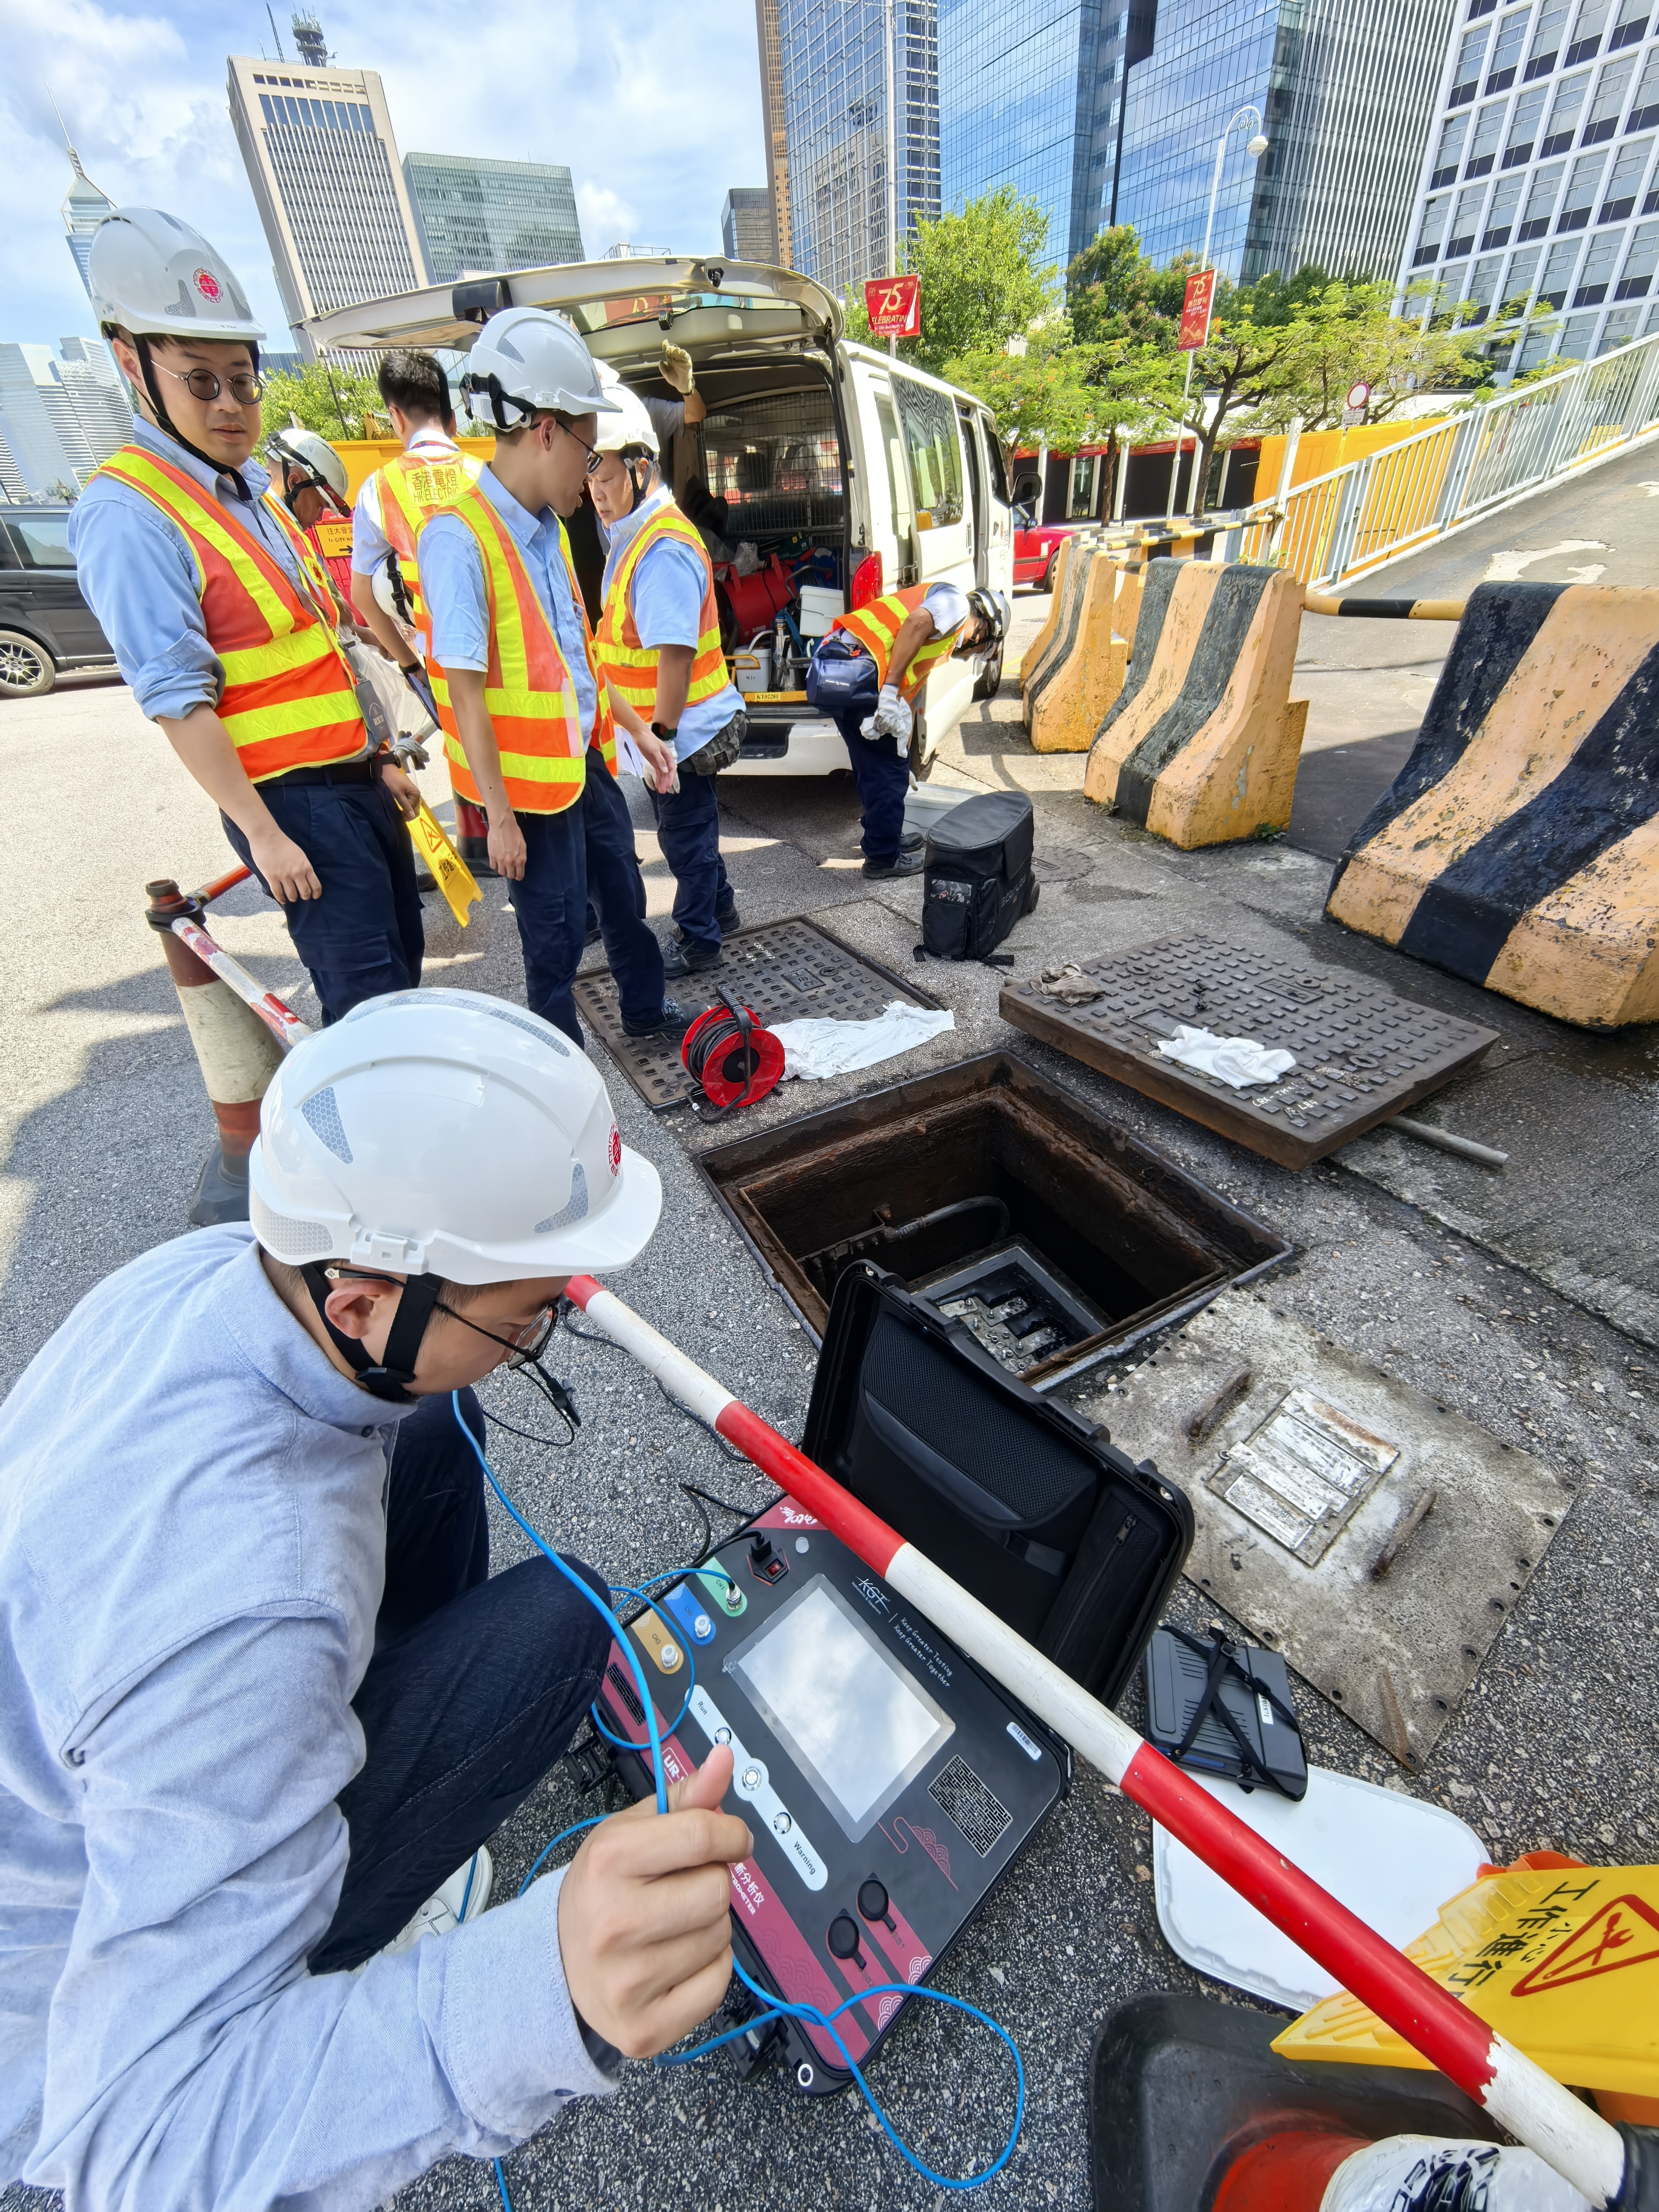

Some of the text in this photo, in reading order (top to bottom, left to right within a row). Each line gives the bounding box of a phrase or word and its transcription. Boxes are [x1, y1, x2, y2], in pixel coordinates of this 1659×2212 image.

[879, 283, 904, 315] 75
[871, 314, 907, 324] ELEBRATIN
[411, 468, 459, 491] 香港電燈
[413, 487, 460, 503] HK ELECTRIC
[373, 715, 384, 725] HKU
[715, 1579, 725, 1590] CH1
[859, 1578, 888, 1603] KGT
[652, 1633, 661, 1645] CH3
[900, 1617, 953, 1677] Keep Greater Testing
[894, 1624, 951, 1688] Keep Greater Together
[697, 1701, 708, 1715] Run
[794, 1841, 816, 1875] Warning
[729, 1862, 765, 1908] 断分析仪
[731, 1871, 756, 1915] TROMETER
[889, 1931, 905, 1949] SB1
[1520, 1922, 1573, 1963] 小心
